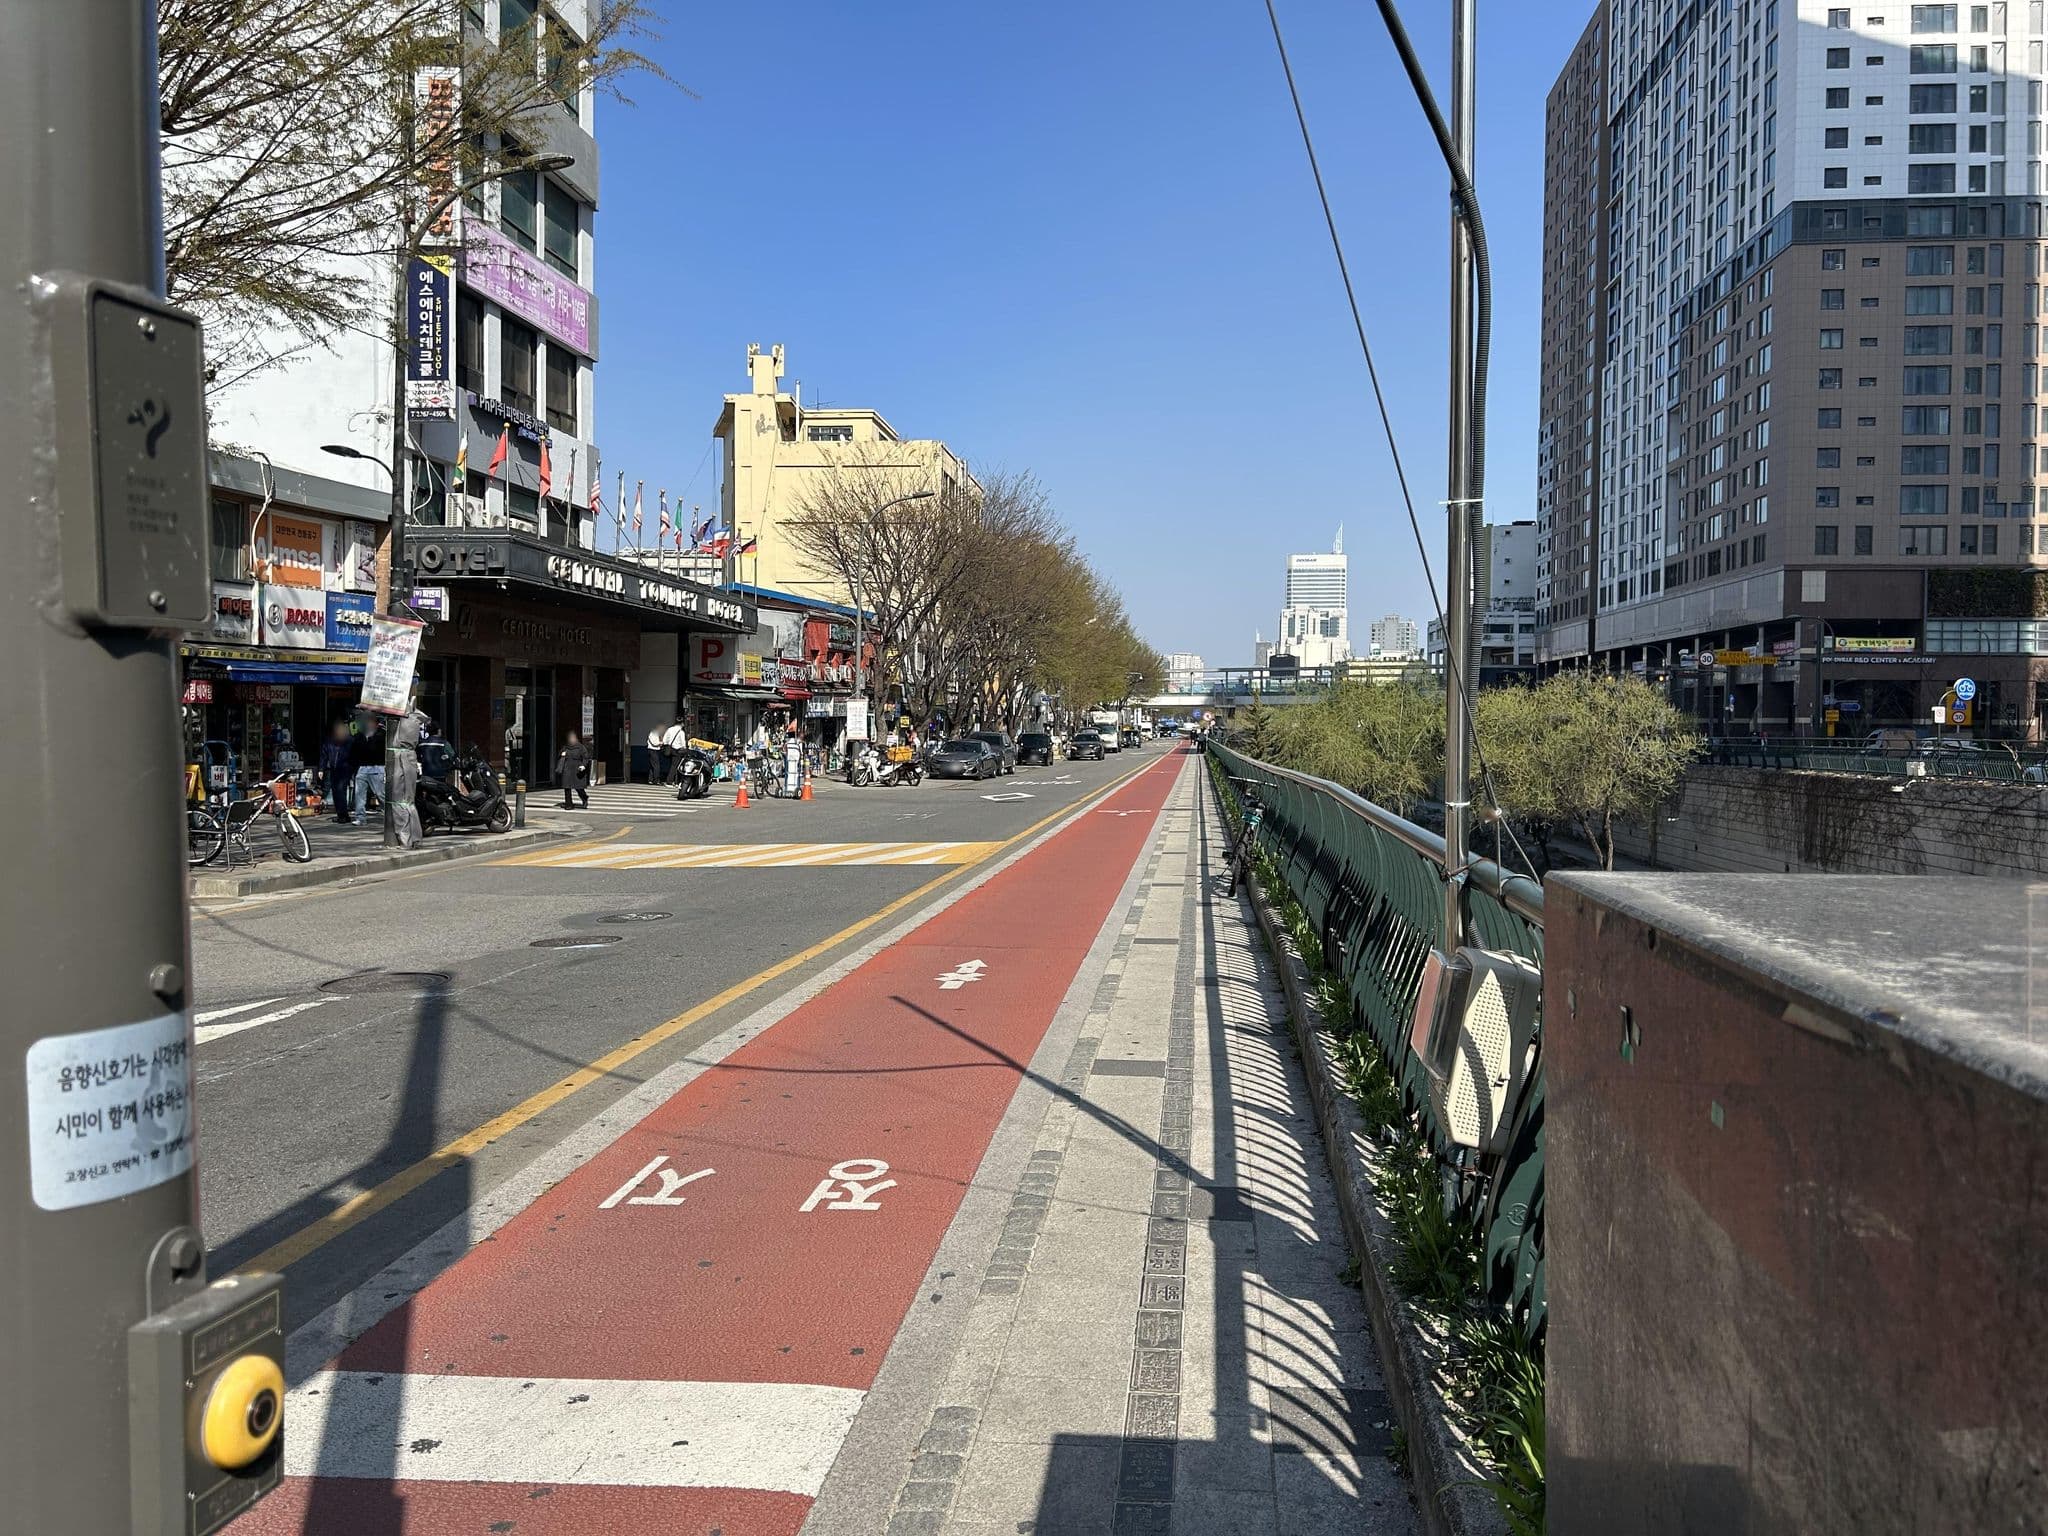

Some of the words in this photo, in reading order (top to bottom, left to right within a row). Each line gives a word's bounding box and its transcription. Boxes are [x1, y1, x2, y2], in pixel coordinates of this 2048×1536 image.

[435, 297, 442, 311] SH
[547, 555, 626, 595] CENTRAL
[639, 579, 699, 612] TOURIST
[707, 598, 744, 624] HOTEL
[284, 608, 324, 627] BOSCH
[502, 619, 551, 641] CENTRAL
[560, 626, 592, 645] HOTEL
[701, 639, 724, 668] P
[57, 1053, 148, 1093] 음향신호기는
[55, 1108, 102, 1139] 시민이
[108, 1100, 138, 1130] 함께
[64, 1164, 109, 1183] 고장신고
[112, 1156, 140, 1174] 연락처
